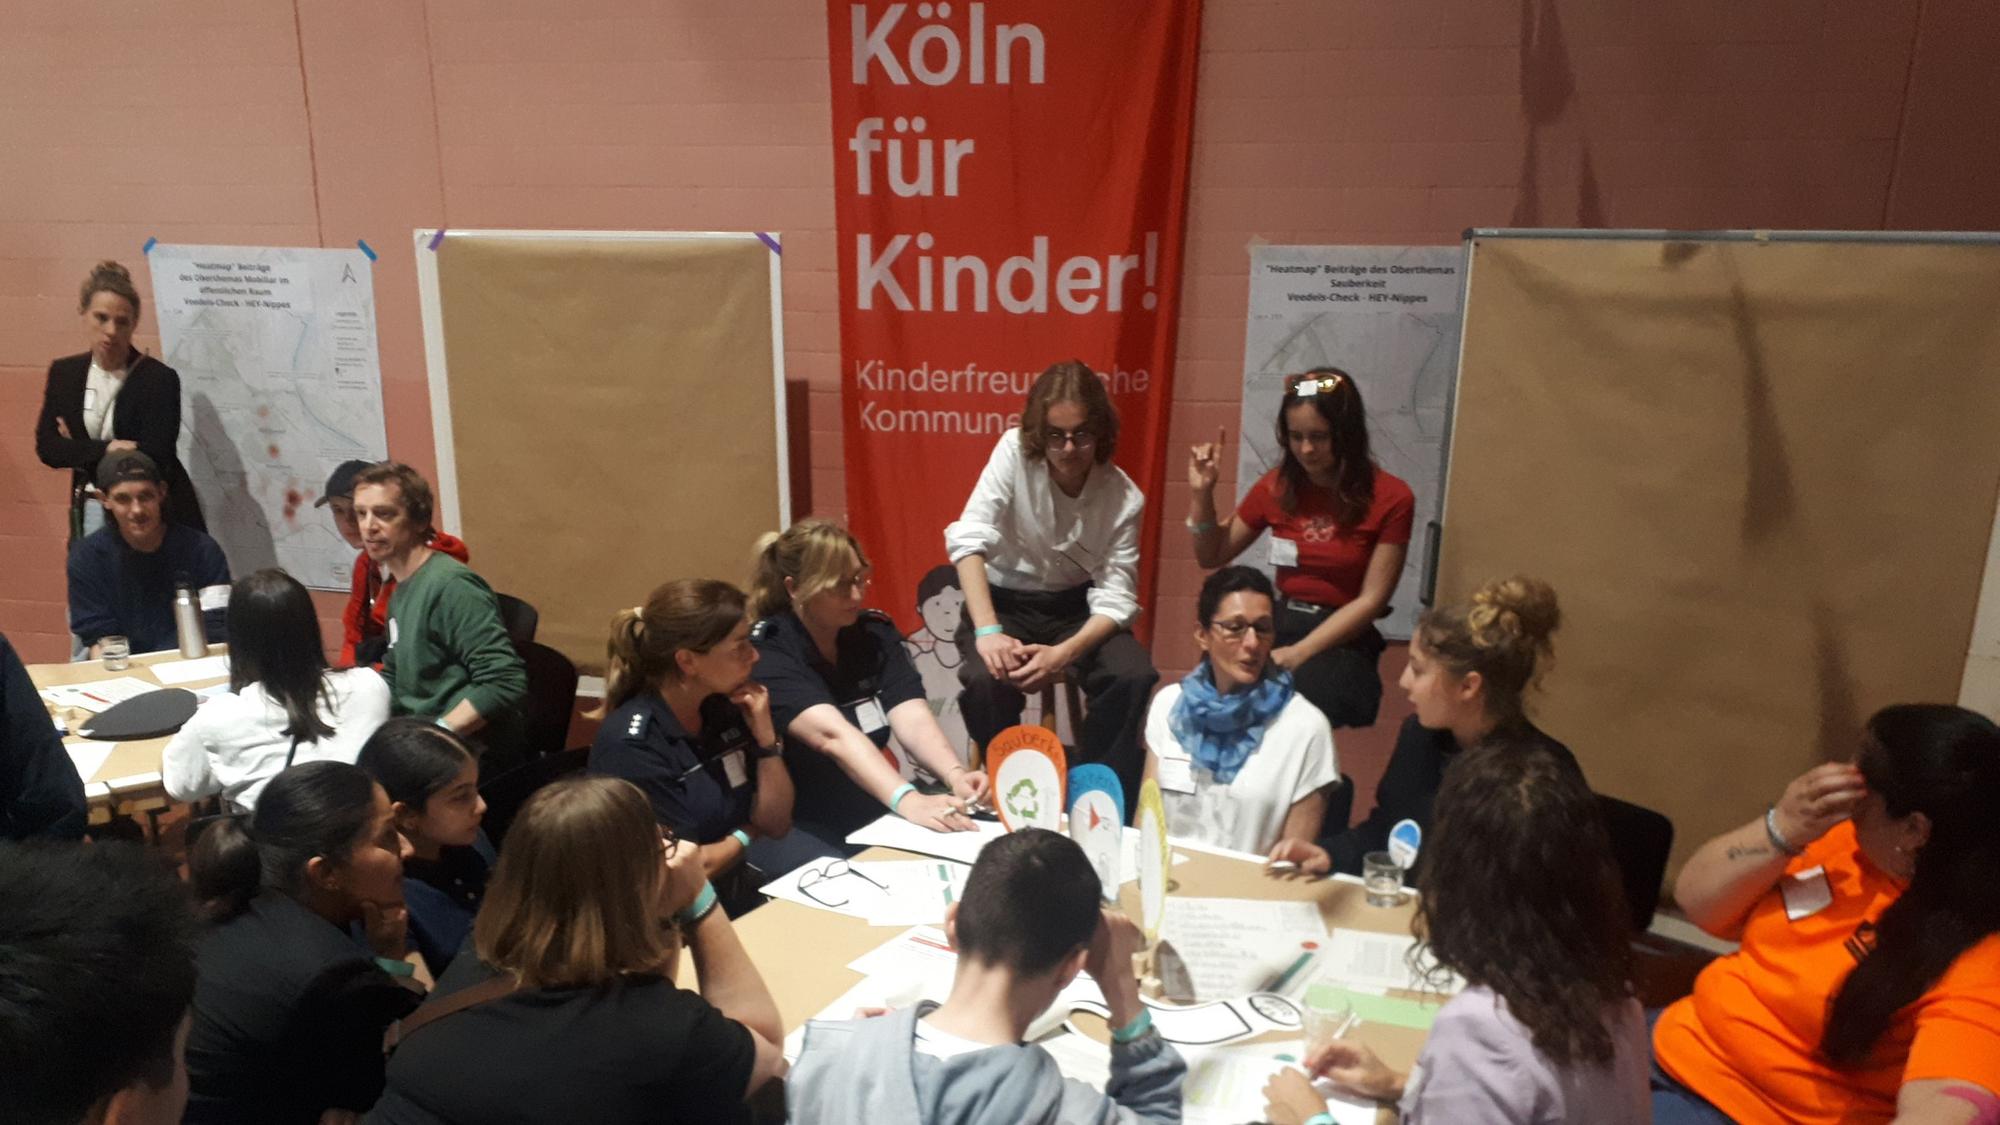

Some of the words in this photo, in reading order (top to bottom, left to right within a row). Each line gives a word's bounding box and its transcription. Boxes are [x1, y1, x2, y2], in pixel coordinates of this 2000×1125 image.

[851, 2, 1045, 86] Köln
[848, 116, 975, 198] für
[857, 230, 1158, 315] Kinder!
[1266, 264, 1322, 276] "Heatmap"
[1324, 264, 1367, 276] Beiträge
[1369, 264, 1387, 275] des
[1389, 264, 1456, 275] Oberthemas
[1330, 278, 1387, 288] Sauberkeit
[1287, 292, 1360, 302] Veedels-Check
[856, 359, 1149, 395] Kinderfreuhe
[858, 401, 1021, 434] Kommune
